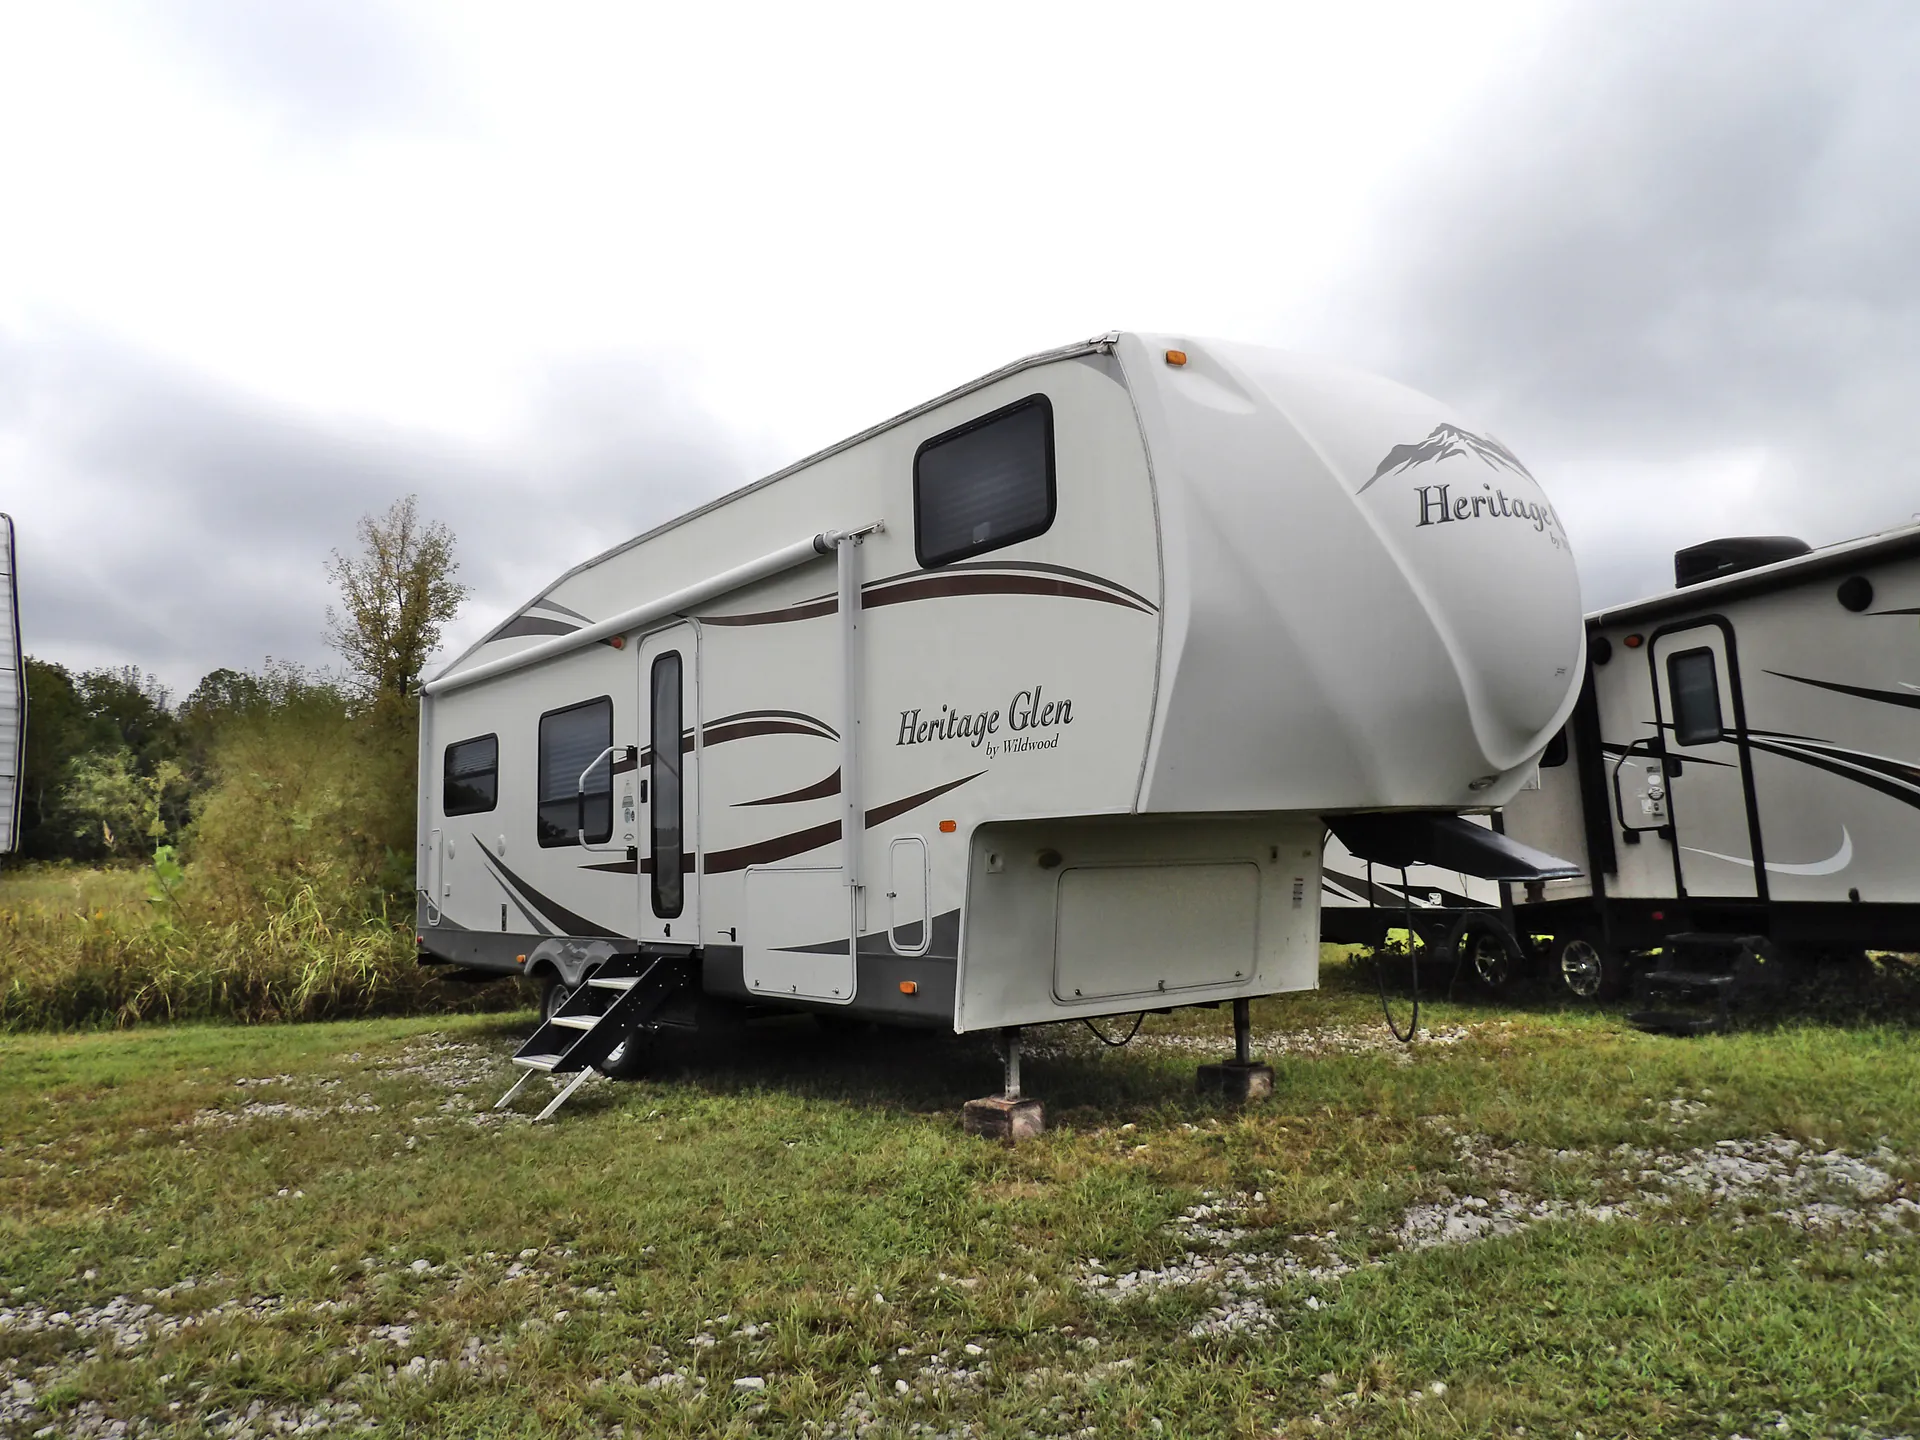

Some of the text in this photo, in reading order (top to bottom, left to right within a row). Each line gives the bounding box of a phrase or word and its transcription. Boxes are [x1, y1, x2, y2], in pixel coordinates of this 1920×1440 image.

[1413, 482, 1552, 533] Heritage
[895, 685, 1074, 748] Heritage Glen
[985, 732, 1060, 760] by Wildwood
